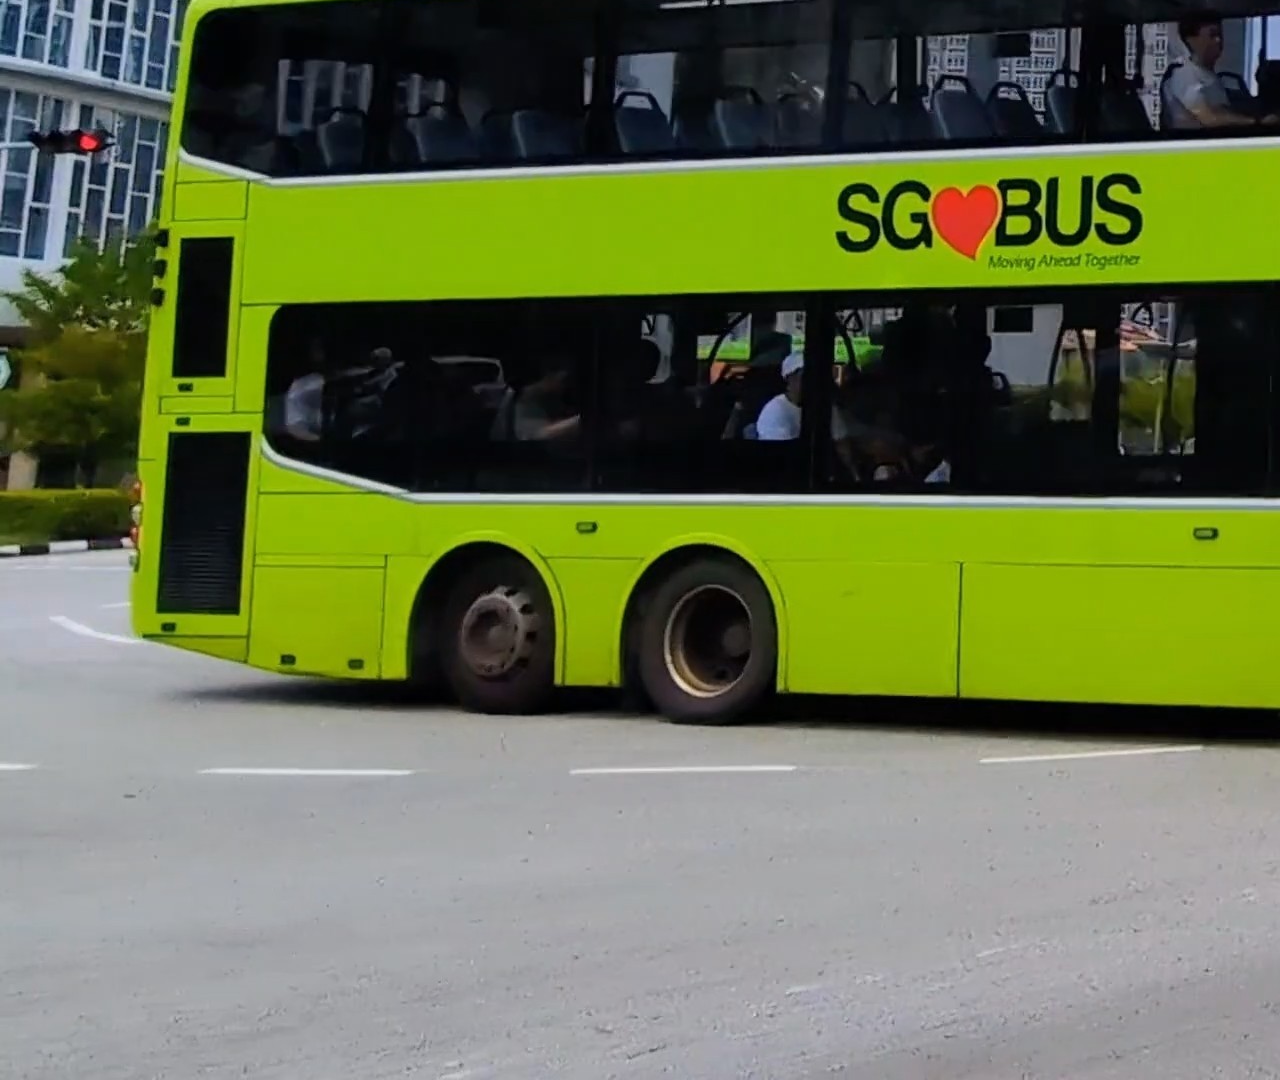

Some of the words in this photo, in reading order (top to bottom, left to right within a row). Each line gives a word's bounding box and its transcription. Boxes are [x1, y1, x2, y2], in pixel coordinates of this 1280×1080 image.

[835, 180, 934, 253] SG
[995, 173, 1143, 248] BUS
[987, 254, 1036, 271] Moving
[1038, 254, 1082, 268] Ahead
[1085, 253, 1141, 270] Together
